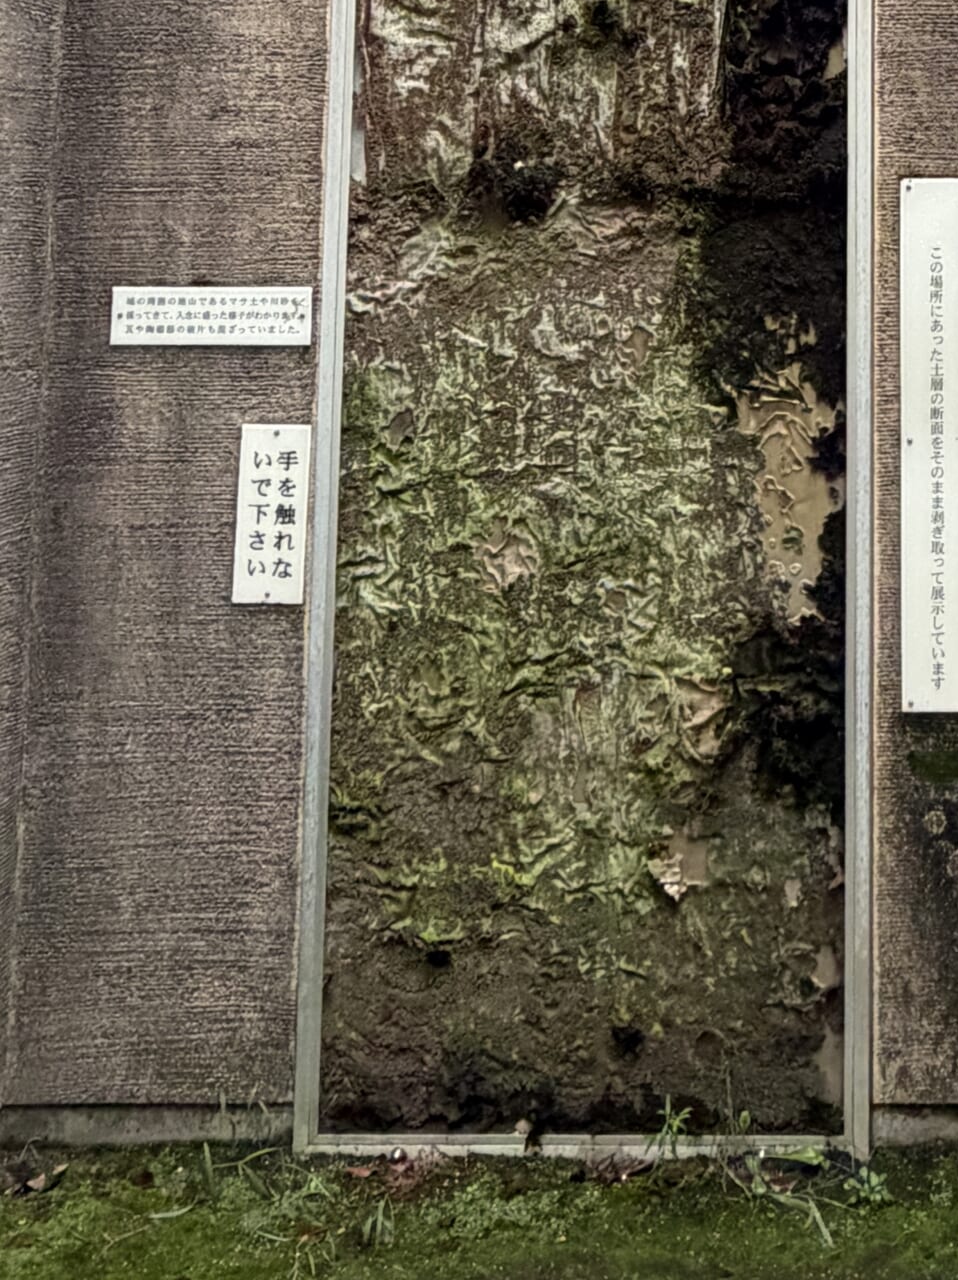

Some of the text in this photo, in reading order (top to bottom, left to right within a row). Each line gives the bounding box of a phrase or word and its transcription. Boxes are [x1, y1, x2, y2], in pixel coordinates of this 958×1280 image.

[247, 450, 273, 577] いで下さい
[272, 450, 300, 579] 手を触れな
[929, 246, 946, 691] この場所にあった土層の断面をそのまま剥ぎ取って展示しています
